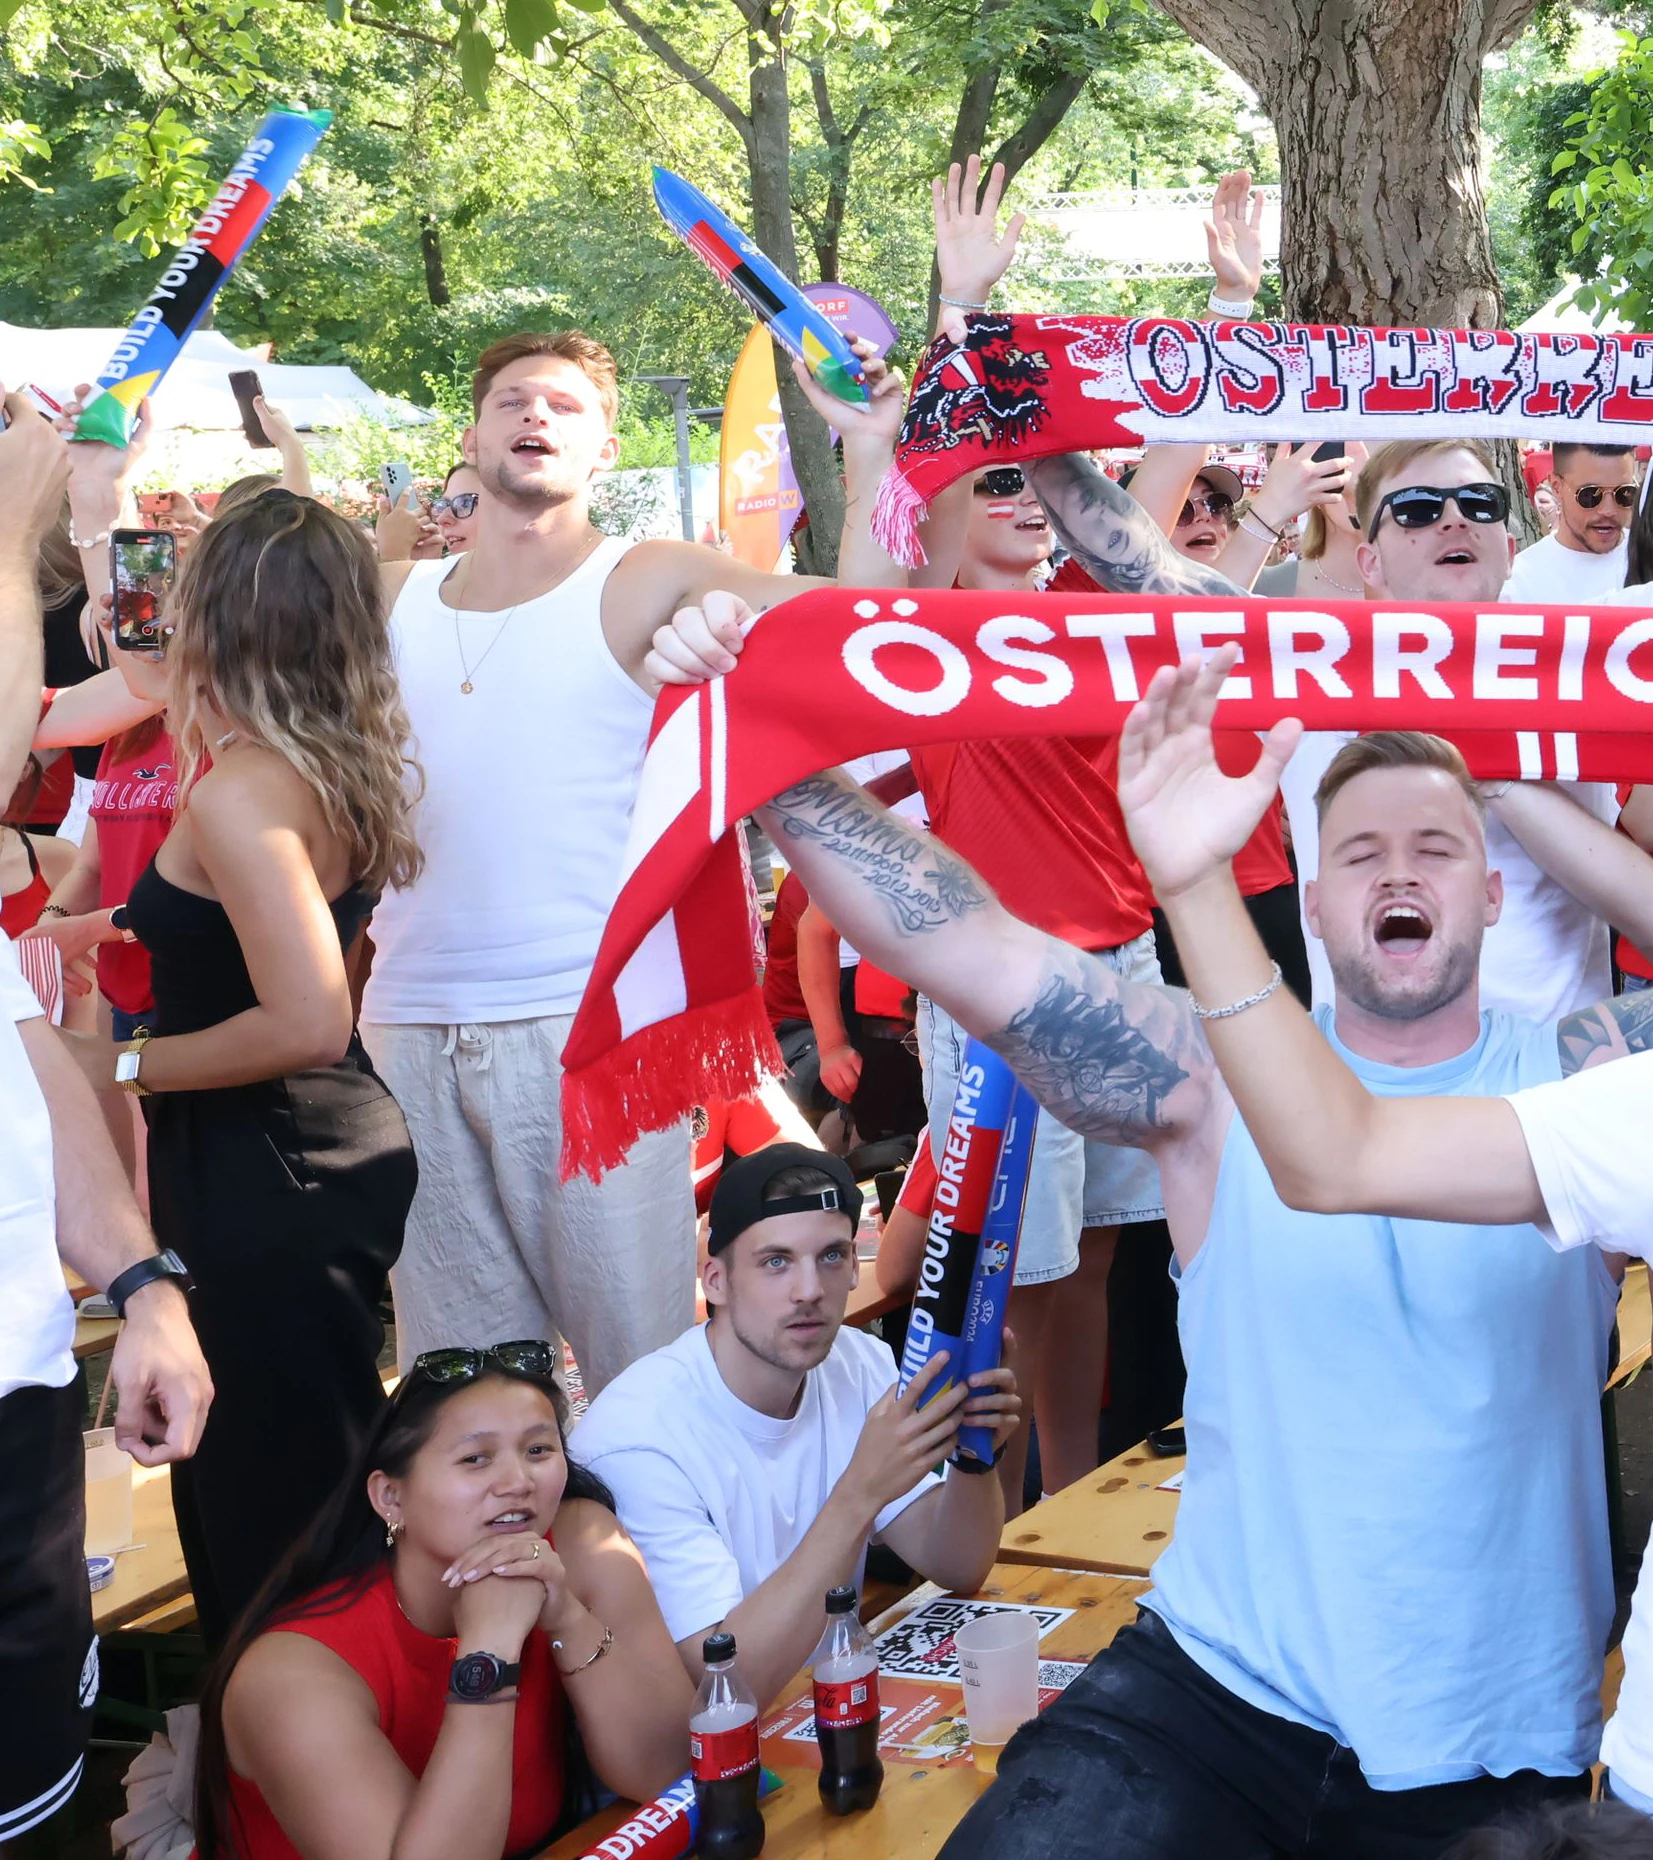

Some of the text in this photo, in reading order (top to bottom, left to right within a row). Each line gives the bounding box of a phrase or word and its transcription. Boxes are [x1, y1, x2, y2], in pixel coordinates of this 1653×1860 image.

[103, 137, 275, 381] BUILD YOUR DREAMS
[818, 301, 846, 312] ORF
[736, 492, 796, 512] RADIO W
[935, 1061, 986, 1207] DREAMS
[917, 1211, 956, 1300] YOUR
[596, 1778, 696, 1860] DREAM
